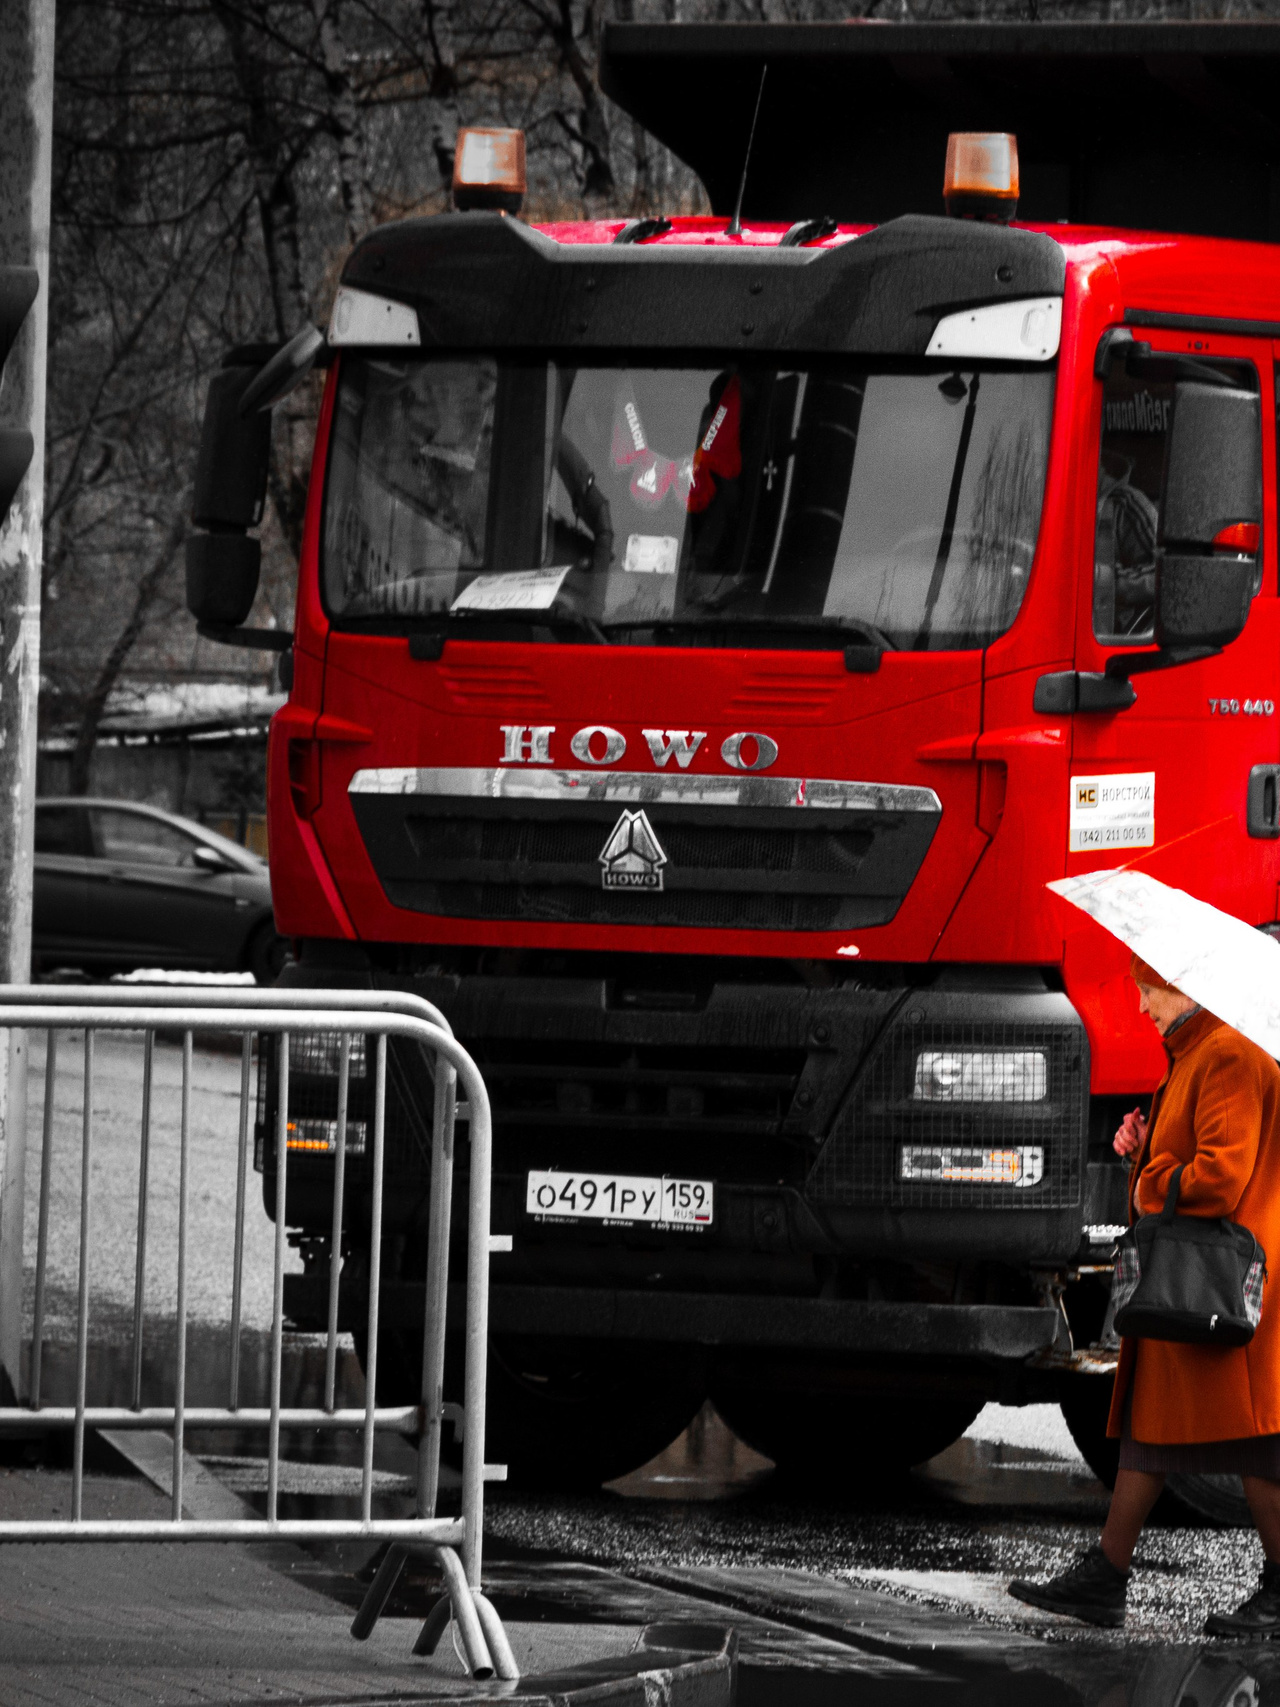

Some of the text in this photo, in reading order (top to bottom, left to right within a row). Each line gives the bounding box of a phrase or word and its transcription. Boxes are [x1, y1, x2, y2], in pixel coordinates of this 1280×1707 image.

[1243, 698, 1275, 717] 440
[499, 724, 779, 771] HOWO
[1101, 781, 1151, 802] НОРСТРОЙ
[1079, 830, 1103, 846] (342)
[1106, 828, 1120, 841] 211
[606, 873, 659, 887] HOWO
[665, 1182, 706, 1209] 159
[673, 1208, 694, 1220] RUS
